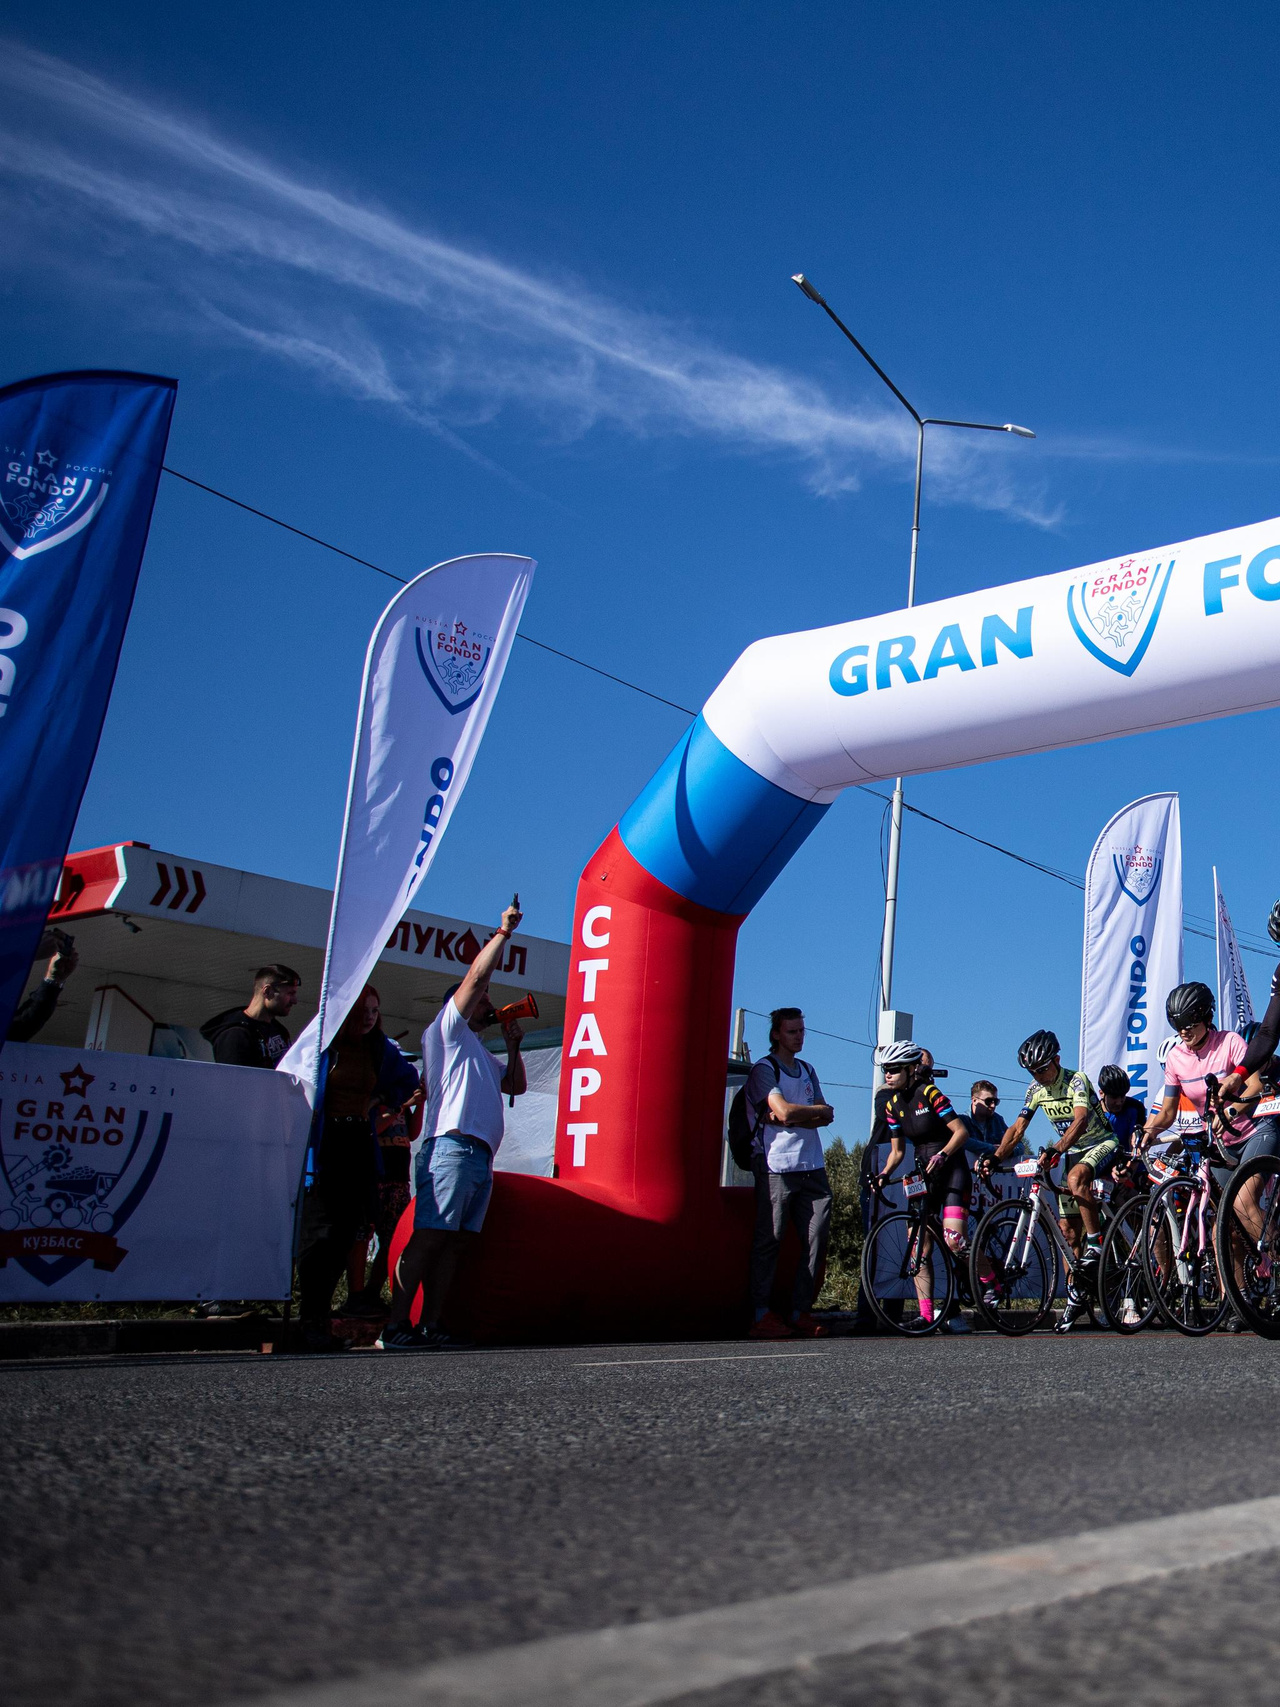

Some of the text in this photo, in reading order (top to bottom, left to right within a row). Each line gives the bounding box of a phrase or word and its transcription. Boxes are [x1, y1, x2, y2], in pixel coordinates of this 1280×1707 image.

[7, 462, 78, 486] GRAN
[65, 463, 113, 477] РОССИЯ
[5, 473, 76, 496] FONDO
[1093, 566, 1150, 586] GRAN
[1091, 577, 1147, 598] FONDO
[415, 616, 448, 628] RUSSIA
[437, 633, 481, 652] GRAN
[472, 631, 497, 642] РОСС
[437, 641, 481, 661] FONDO
[828, 605, 1034, 697] GRAN
[406, 757, 454, 898] NDO
[1125, 854, 1153, 862] GRAN
[1127, 935, 1148, 1117] AN FONDO
[566, 905, 612, 1167] СТАРТ
[0, 1071, 44, 1085] SSIA
[109, 1082, 175, 1097] 2021
[16, 1099, 126, 1125] GRAN
[1260, 1101, 1280, 1113] 2011
[14, 1122, 124, 1146] FONDO
[1056, 1121, 1072, 1129] SAX
[1017, 1164, 1035, 1174] 2020
[907, 1183, 923, 1194] 2010
[23, 1236, 84, 1249] КУЗБАСС
